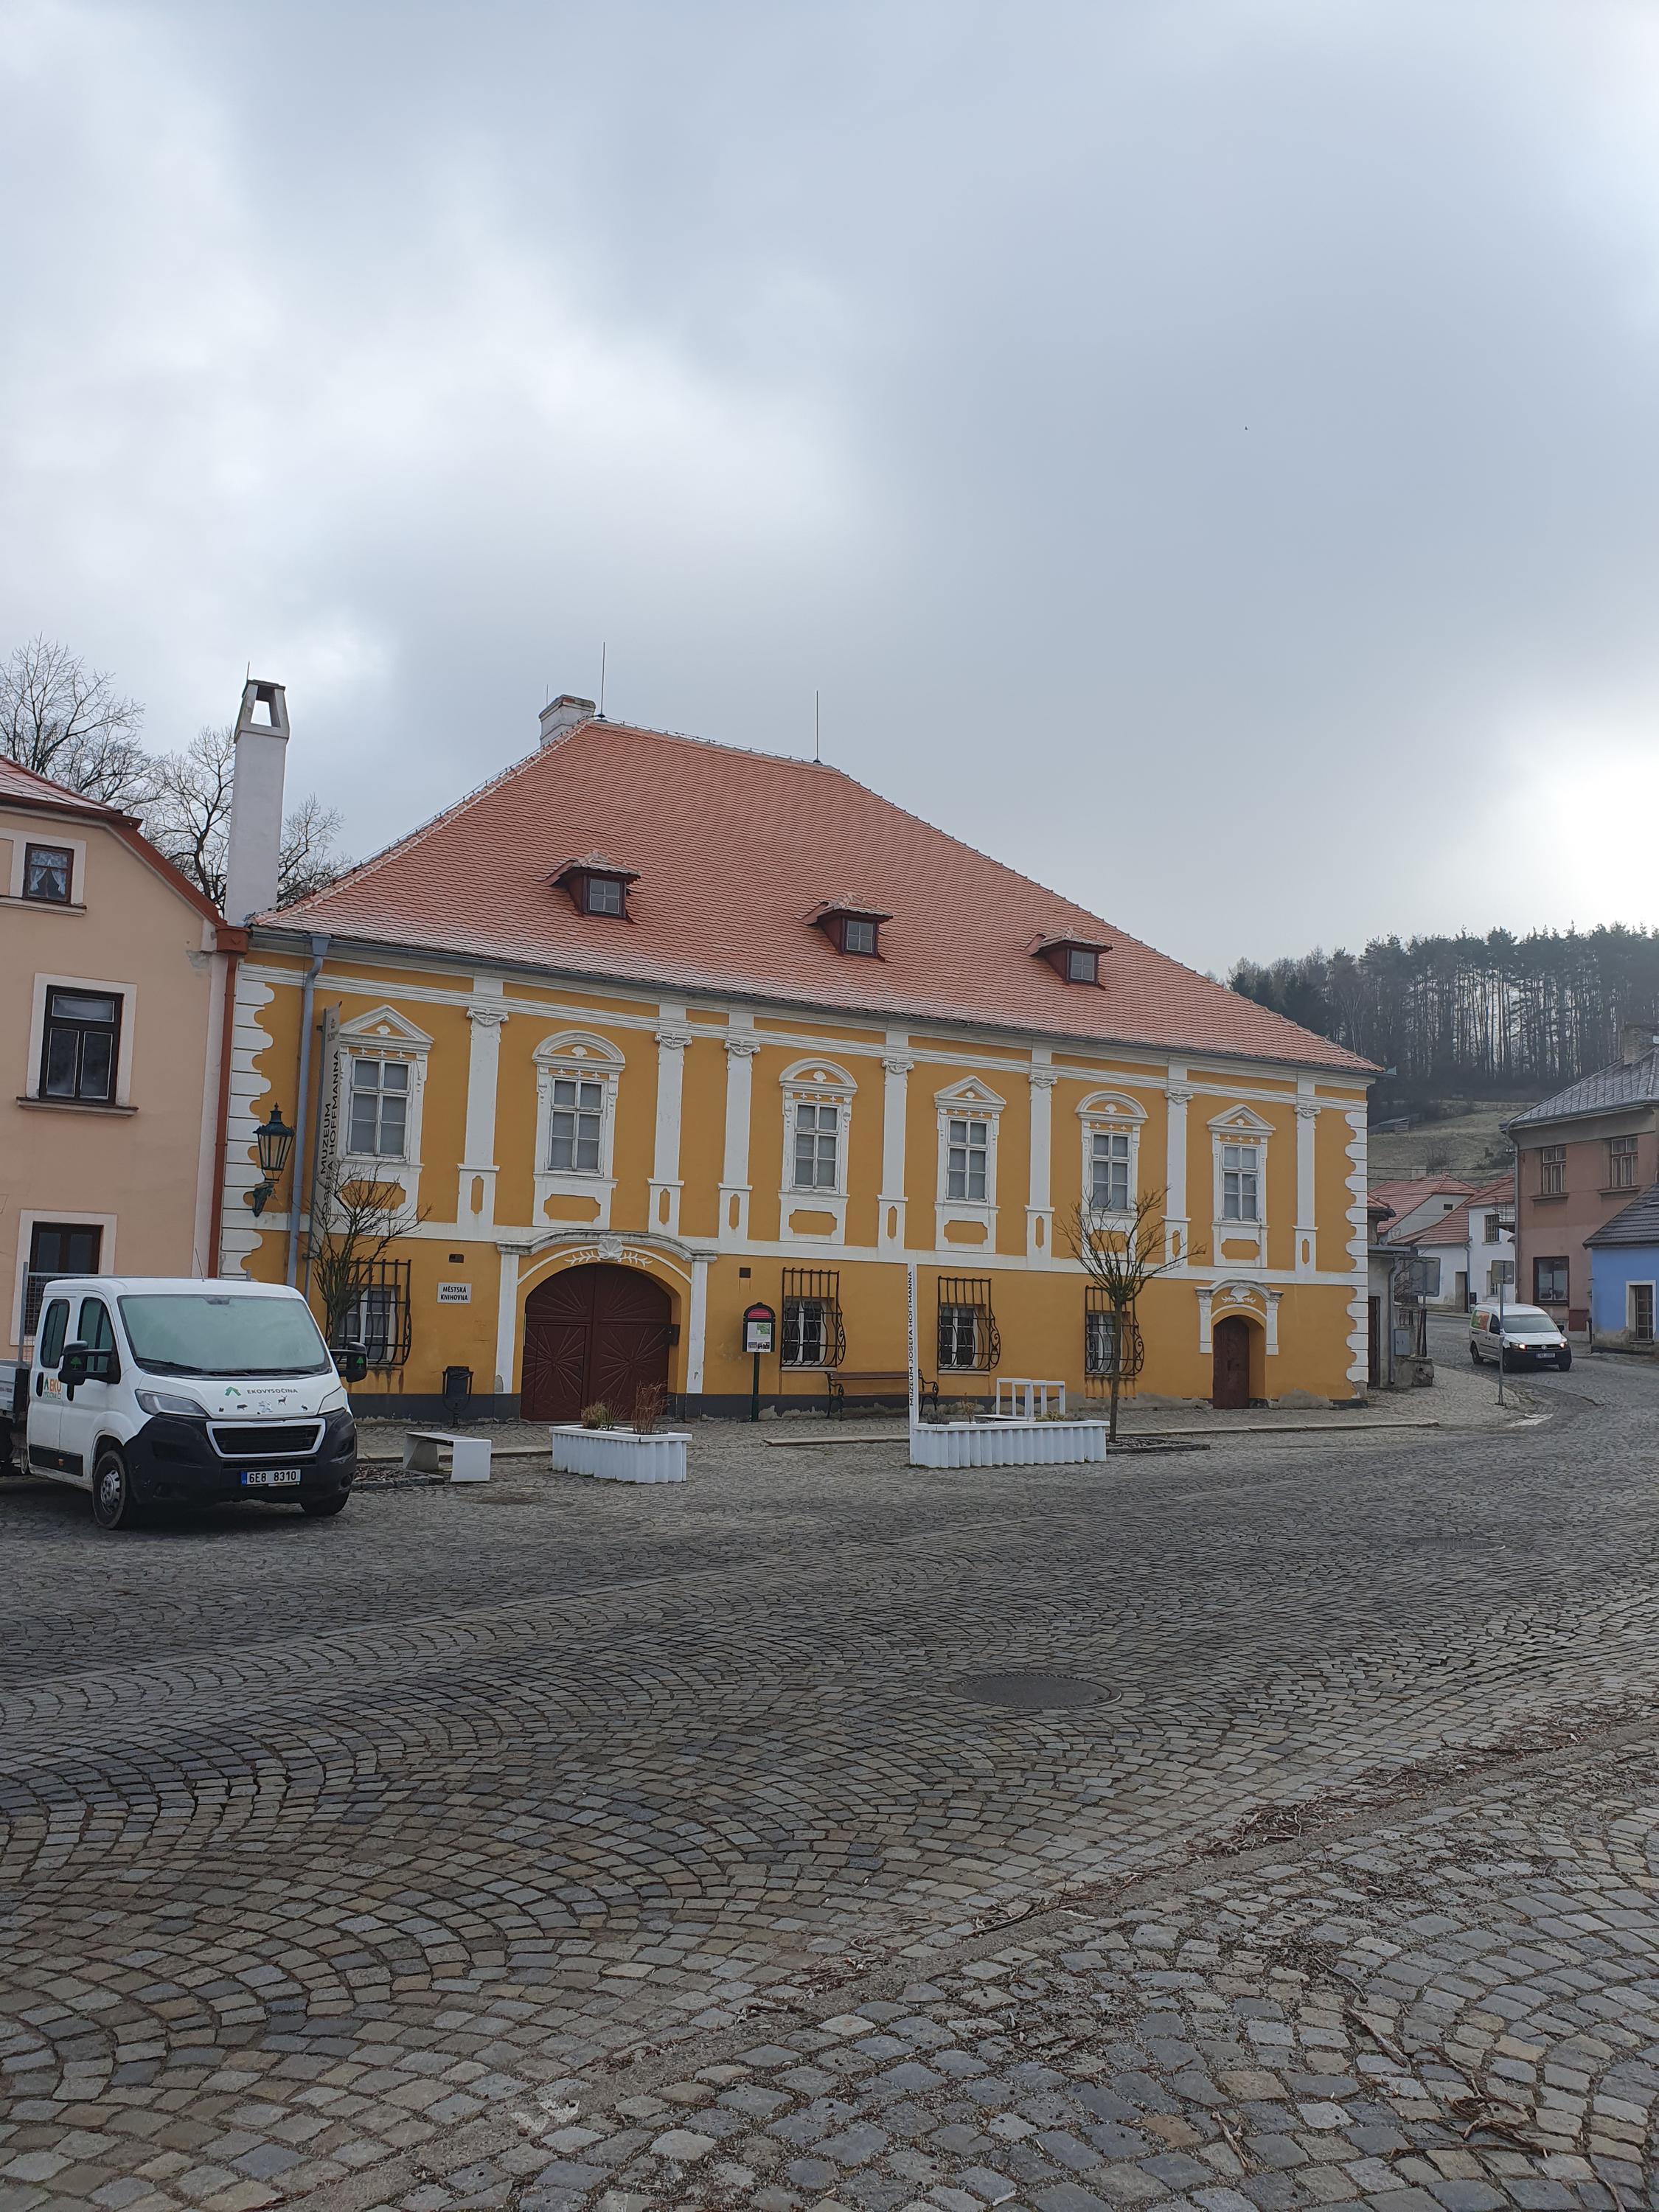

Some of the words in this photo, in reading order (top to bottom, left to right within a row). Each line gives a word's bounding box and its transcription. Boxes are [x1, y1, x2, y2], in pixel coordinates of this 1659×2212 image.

[329, 1050, 339, 1155] HOFFMANNA
[321, 1103, 331, 1174] MUZEUM
[442, 1285, 467, 1293] MĚSTSKÁ
[249, 1472, 267, 1483] 6E8
[274, 1470, 296, 1481] 8310
